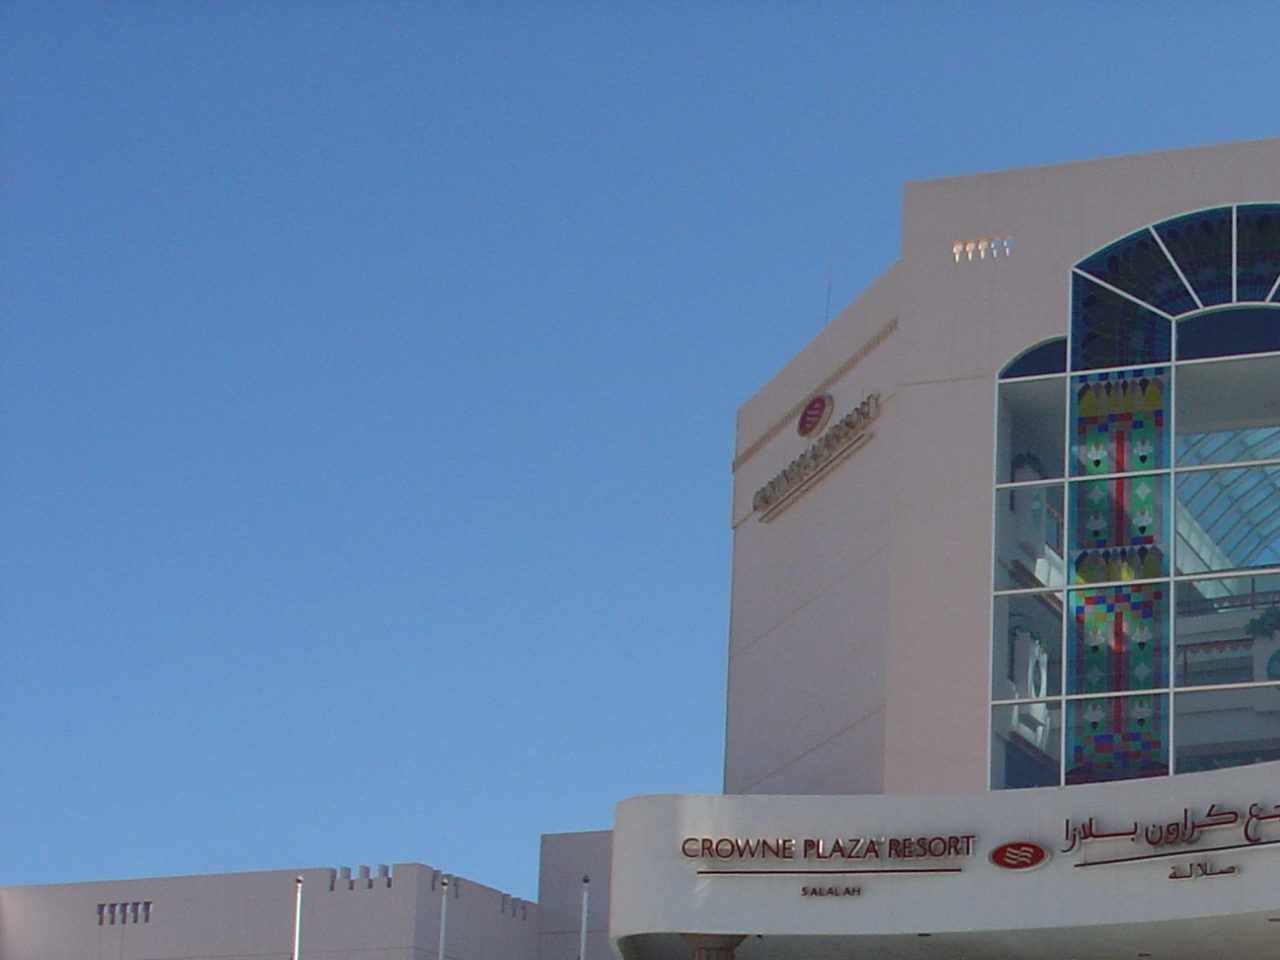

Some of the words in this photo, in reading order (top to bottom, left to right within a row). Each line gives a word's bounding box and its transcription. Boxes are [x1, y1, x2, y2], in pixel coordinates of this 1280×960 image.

[1059, 817, 1139, 853] بلازا
[1143, 803, 1239, 846] كراون
[681, 837, 796, 860] CROWNE
[802, 837, 880, 860] PLAZA
[887, 834, 977, 859] RESORT
[1167, 861, 1237, 880] صلالة
[800, 885, 862, 897] SALALAH
